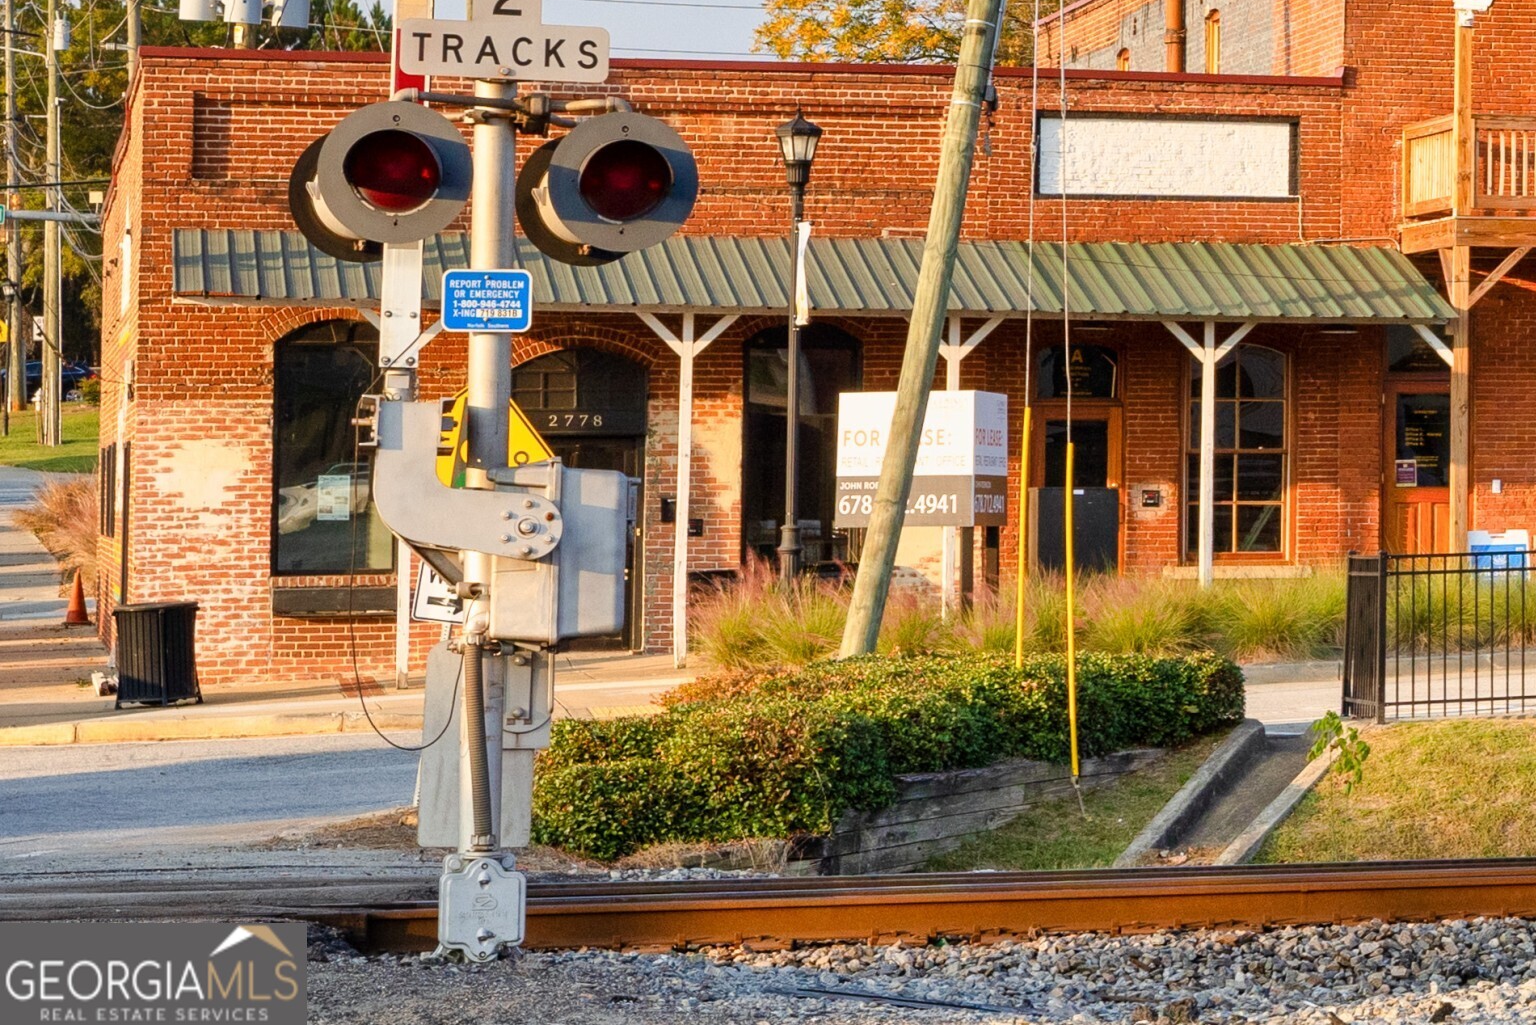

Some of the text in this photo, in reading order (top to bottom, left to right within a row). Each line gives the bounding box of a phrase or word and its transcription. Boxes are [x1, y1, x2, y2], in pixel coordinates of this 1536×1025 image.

[412, 32, 599, 69] TRACKS
[449, 279, 525, 289] REPORT PROBLEM
[453, 289, 520, 298] OR EMERGENCY
[452, 299, 521, 308] 1-800-946-4744
[452, 309, 476, 318] X-ING
[548, 414, 603, 427] 2778
[843, 430, 880, 447] FOR
[840, 481, 862, 490] JOHN
